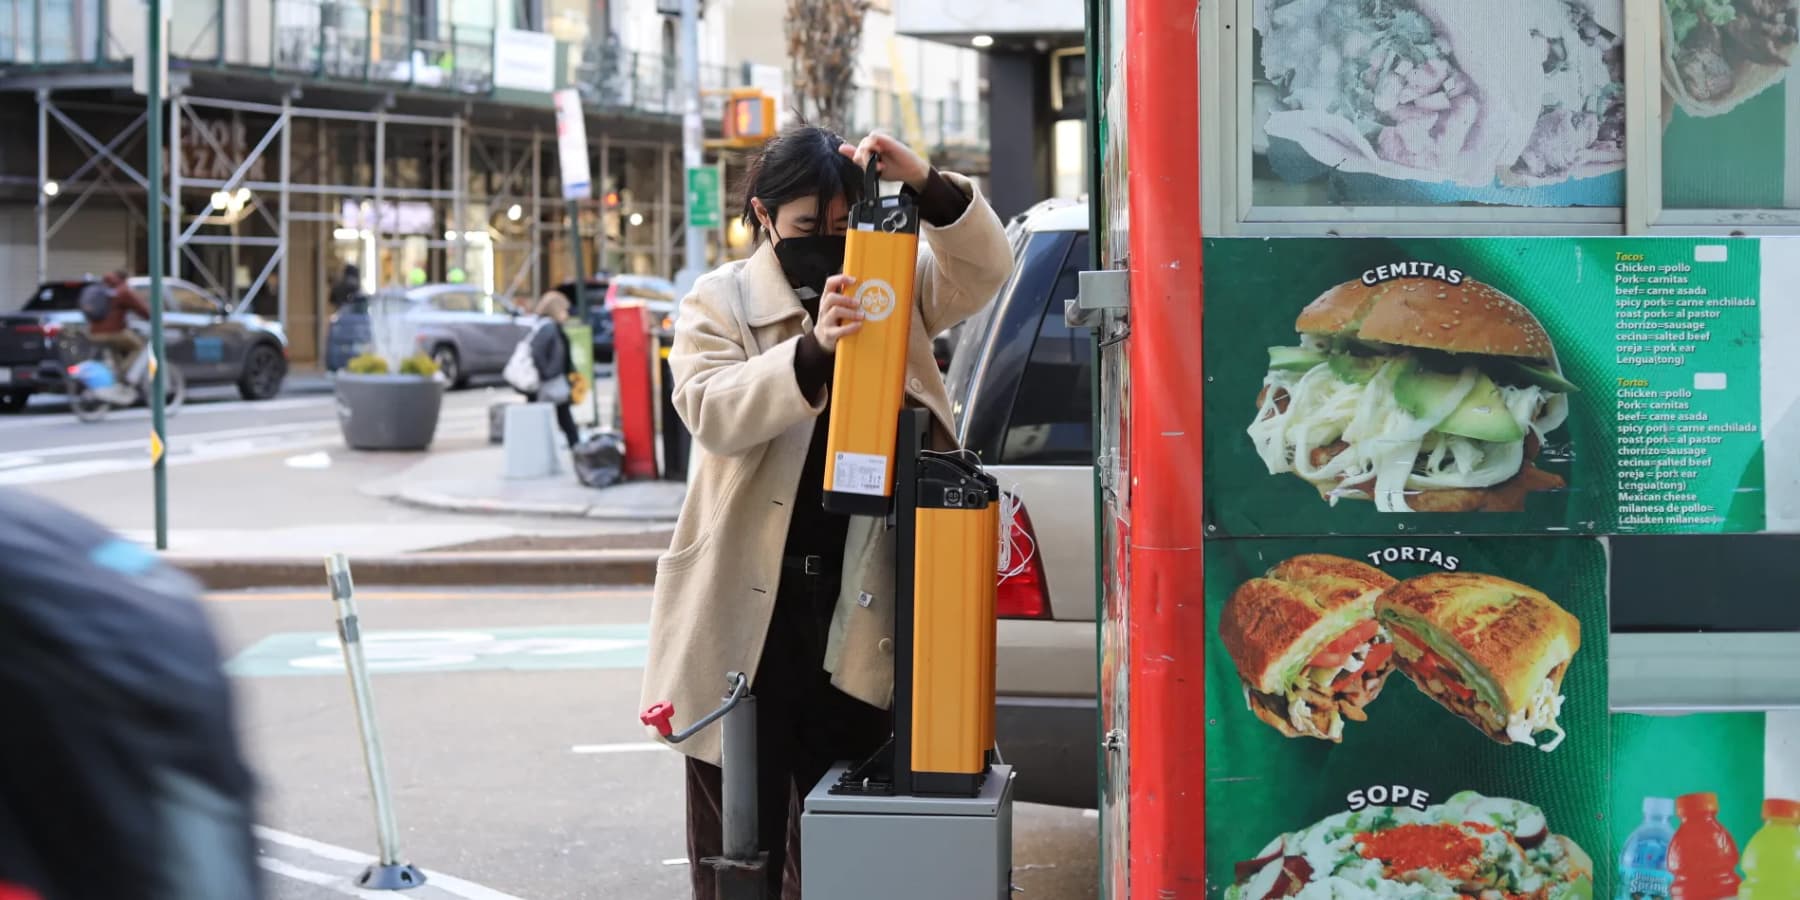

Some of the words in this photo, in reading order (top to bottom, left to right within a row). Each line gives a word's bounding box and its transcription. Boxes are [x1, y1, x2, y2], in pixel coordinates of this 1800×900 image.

[1615, 251, 1644, 261] Tacos
[1361, 261, 1463, 285] CEMITAS
[1615, 263, 1656, 272] Chicken
[1658, 263, 1691, 274] =pollo
[1615, 275, 1646, 283] Pork=
[1615, 285, 1646, 295] beef=
[1677, 286, 1706, 295] asada
[1615, 297, 1641, 308] spicy
[1643, 297, 1675, 309] pork=
[1707, 296, 1756, 306] enchilada
[1616, 309, 1644, 318] roast
[1644, 308, 1675, 320] pork=
[1676, 308, 1685, 318] al
[1688, 309, 1720, 320] pastor
[1687, 331, 1710, 341] beef
[1616, 344, 1642, 354] oreja
[1653, 343, 1677, 354] pork
[1616, 355, 1685, 366] Lengua(tong)
[1616, 377, 1648, 387] Tortas
[1617, 388, 1657, 398] Chicken
[1660, 388, 1692, 399] =pollo
[1617, 400, 1647, 409] Pork=
[1617, 411, 1648, 420] beef=
[1678, 411, 1708, 420] asada
[1617, 423, 1642, 434] spicy
[1708, 423, 1757, 432] enchilada
[1618, 435, 1645, 444] roast
[1677, 435, 1687, 444] al
[1689, 436, 1722, 445] pastor
[1689, 457, 1712, 467] beef
[1618, 470, 1644, 480] oreja
[1656, 469, 1679, 480] pork
[1618, 481, 1686, 492] Lengua(tong)
[1618, 492, 1661, 501] Mexican
[1663, 492, 1697, 501] cheese
[1619, 503, 1664, 513] milanesa
[1666, 503, 1680, 513] de
[1367, 546, 1459, 570] TORTAS
[1346, 785, 1430, 810] SOPE
[1630, 879, 1668, 895] Spring
